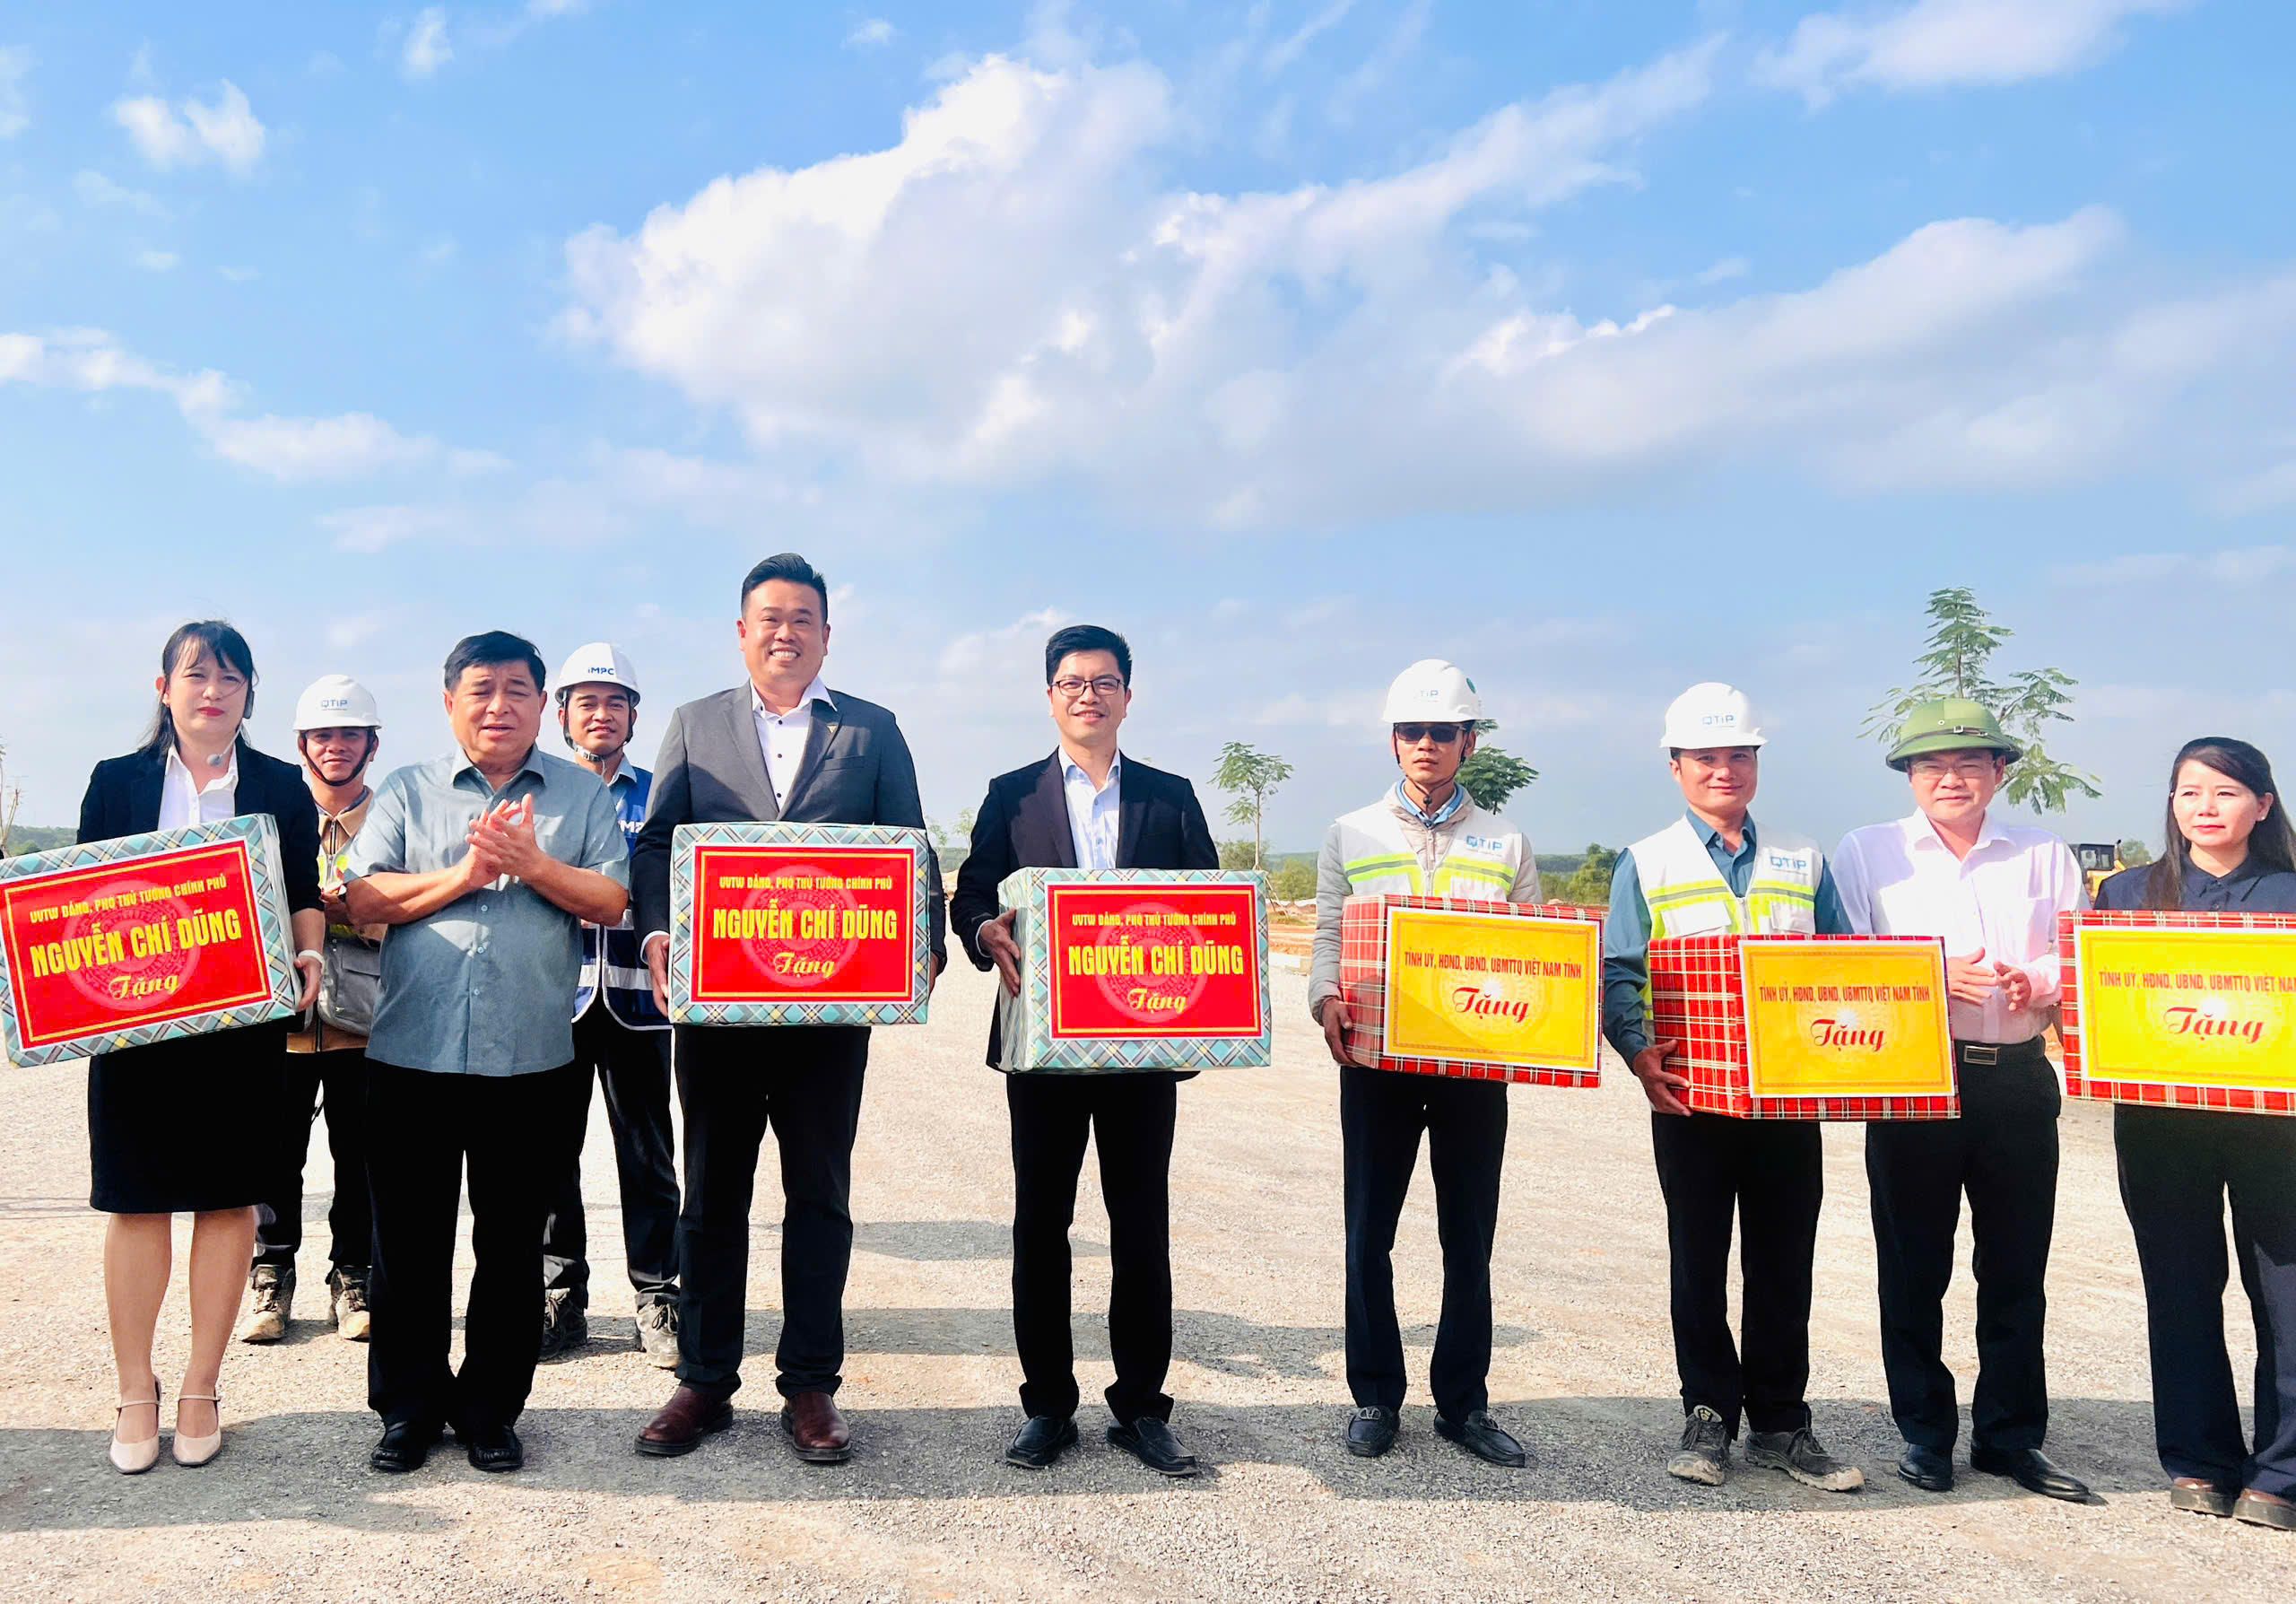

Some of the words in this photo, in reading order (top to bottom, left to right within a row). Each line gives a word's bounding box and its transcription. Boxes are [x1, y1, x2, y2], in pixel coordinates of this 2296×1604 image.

[117, 890, 138, 908] THỦ
[174, 879, 205, 897] CHÍNH
[206, 873, 227, 891] PHỦ
[796, 876, 813, 890] THỦ
[846, 876, 872, 890] CHÍNH
[875, 876, 892, 890] PHỦ
[713, 899, 794, 939] NGUYỄN
[801, 904, 836, 939] CHÍ
[842, 904, 897, 939] DŨNG
[1144, 911, 1161, 926] THỦ
[1192, 911, 1218, 926] CHÍNH
[1220, 911, 1236, 926] PHỦ
[30, 923, 125, 978] NGUYỄN
[130, 916, 172, 958] CHÍ
[178, 909, 242, 950] DŨNG
[1069, 935, 1144, 975] NGUYỄN
[1152, 940, 1184, 975] CHÍ
[1191, 940, 1244, 975] DŨNG
[774, 952, 835, 979] Tặng
[1405, 947, 1422, 967] TỈNH
[1439, 955, 1462, 971] HĐND,
[1465, 955, 1488, 972] UBND,
[1491, 957, 1522, 975] UBMTTQ
[1525, 958, 1541, 978] VIỆT
[1543, 962, 1561, 976] NAM
[1564, 959, 1582, 978] TỈNH
[109, 975, 178, 1000] Tặng
[1760, 981, 1778, 1001] TỈNH
[1794, 987, 1815, 1003] HĐND,
[1818, 987, 1840, 1003] UBND,
[1843, 987, 1873, 1003] UBMTTQ
[1875, 983, 1891, 1005] VIỆT
[1893, 987, 1910, 1001] NAM
[1912, 980, 1930, 1001] TỈNH
[2099, 965, 2120, 987] TỈNH
[2143, 972, 2172, 989] HĐND,
[2176, 974, 2206, 990] UBND,
[2210, 974, 2251, 992] UBMTTQ
[2254, 972, 2275, 994] VIỆT
[1127, 987, 1187, 1014] Tặng
[1452, 987, 1529, 1023] Tặng
[1811, 1019, 1886, 1051] Tặng
[2163, 1007, 2264, 1043] Tặng
